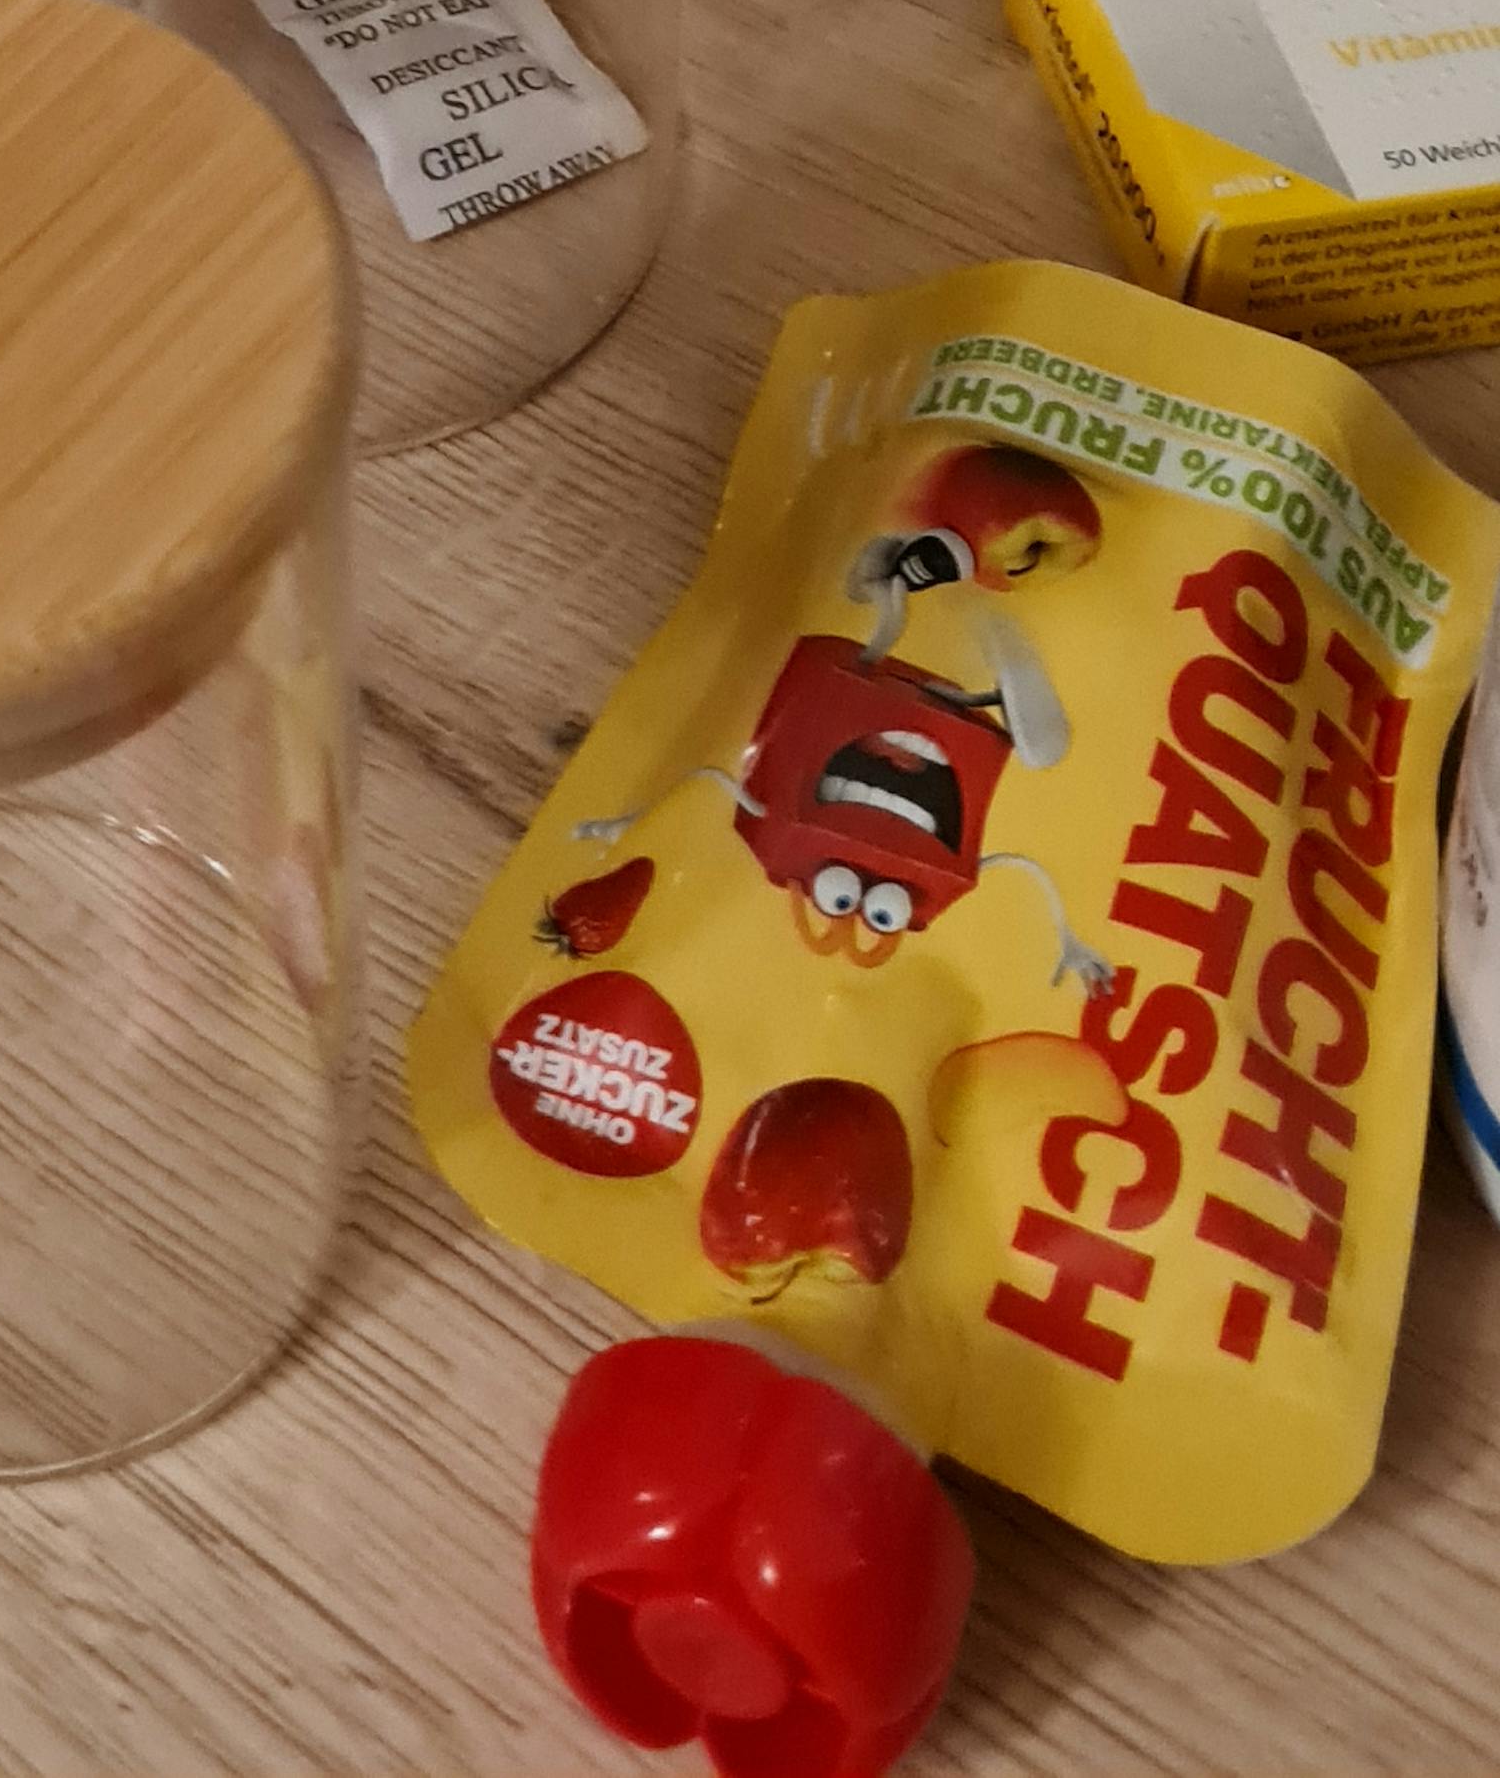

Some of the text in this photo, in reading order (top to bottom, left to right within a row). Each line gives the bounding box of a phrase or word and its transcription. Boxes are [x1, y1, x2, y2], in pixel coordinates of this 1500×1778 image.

[380, 3, 438, 35] NOT
[369, 35, 528, 96] DESICCANT
[441, 65, 576, 123] SILICA
[418, 131, 504, 182] GEL
[438, 144, 616, 228] THROW AWAY
[1382, 148, 1417, 170] 50
[915, 376, 1431, 654] AUS 100% FRUCHT
[983, 547, 1309, 1383] QUATSCH
[1195, 629, 1411, 1364] FRUCHT-
[533, 1012, 674, 1080] ZUSATZ
[496, 1039, 697, 1134] ZUCKER-
[535, 1091, 636, 1145] OHNE
